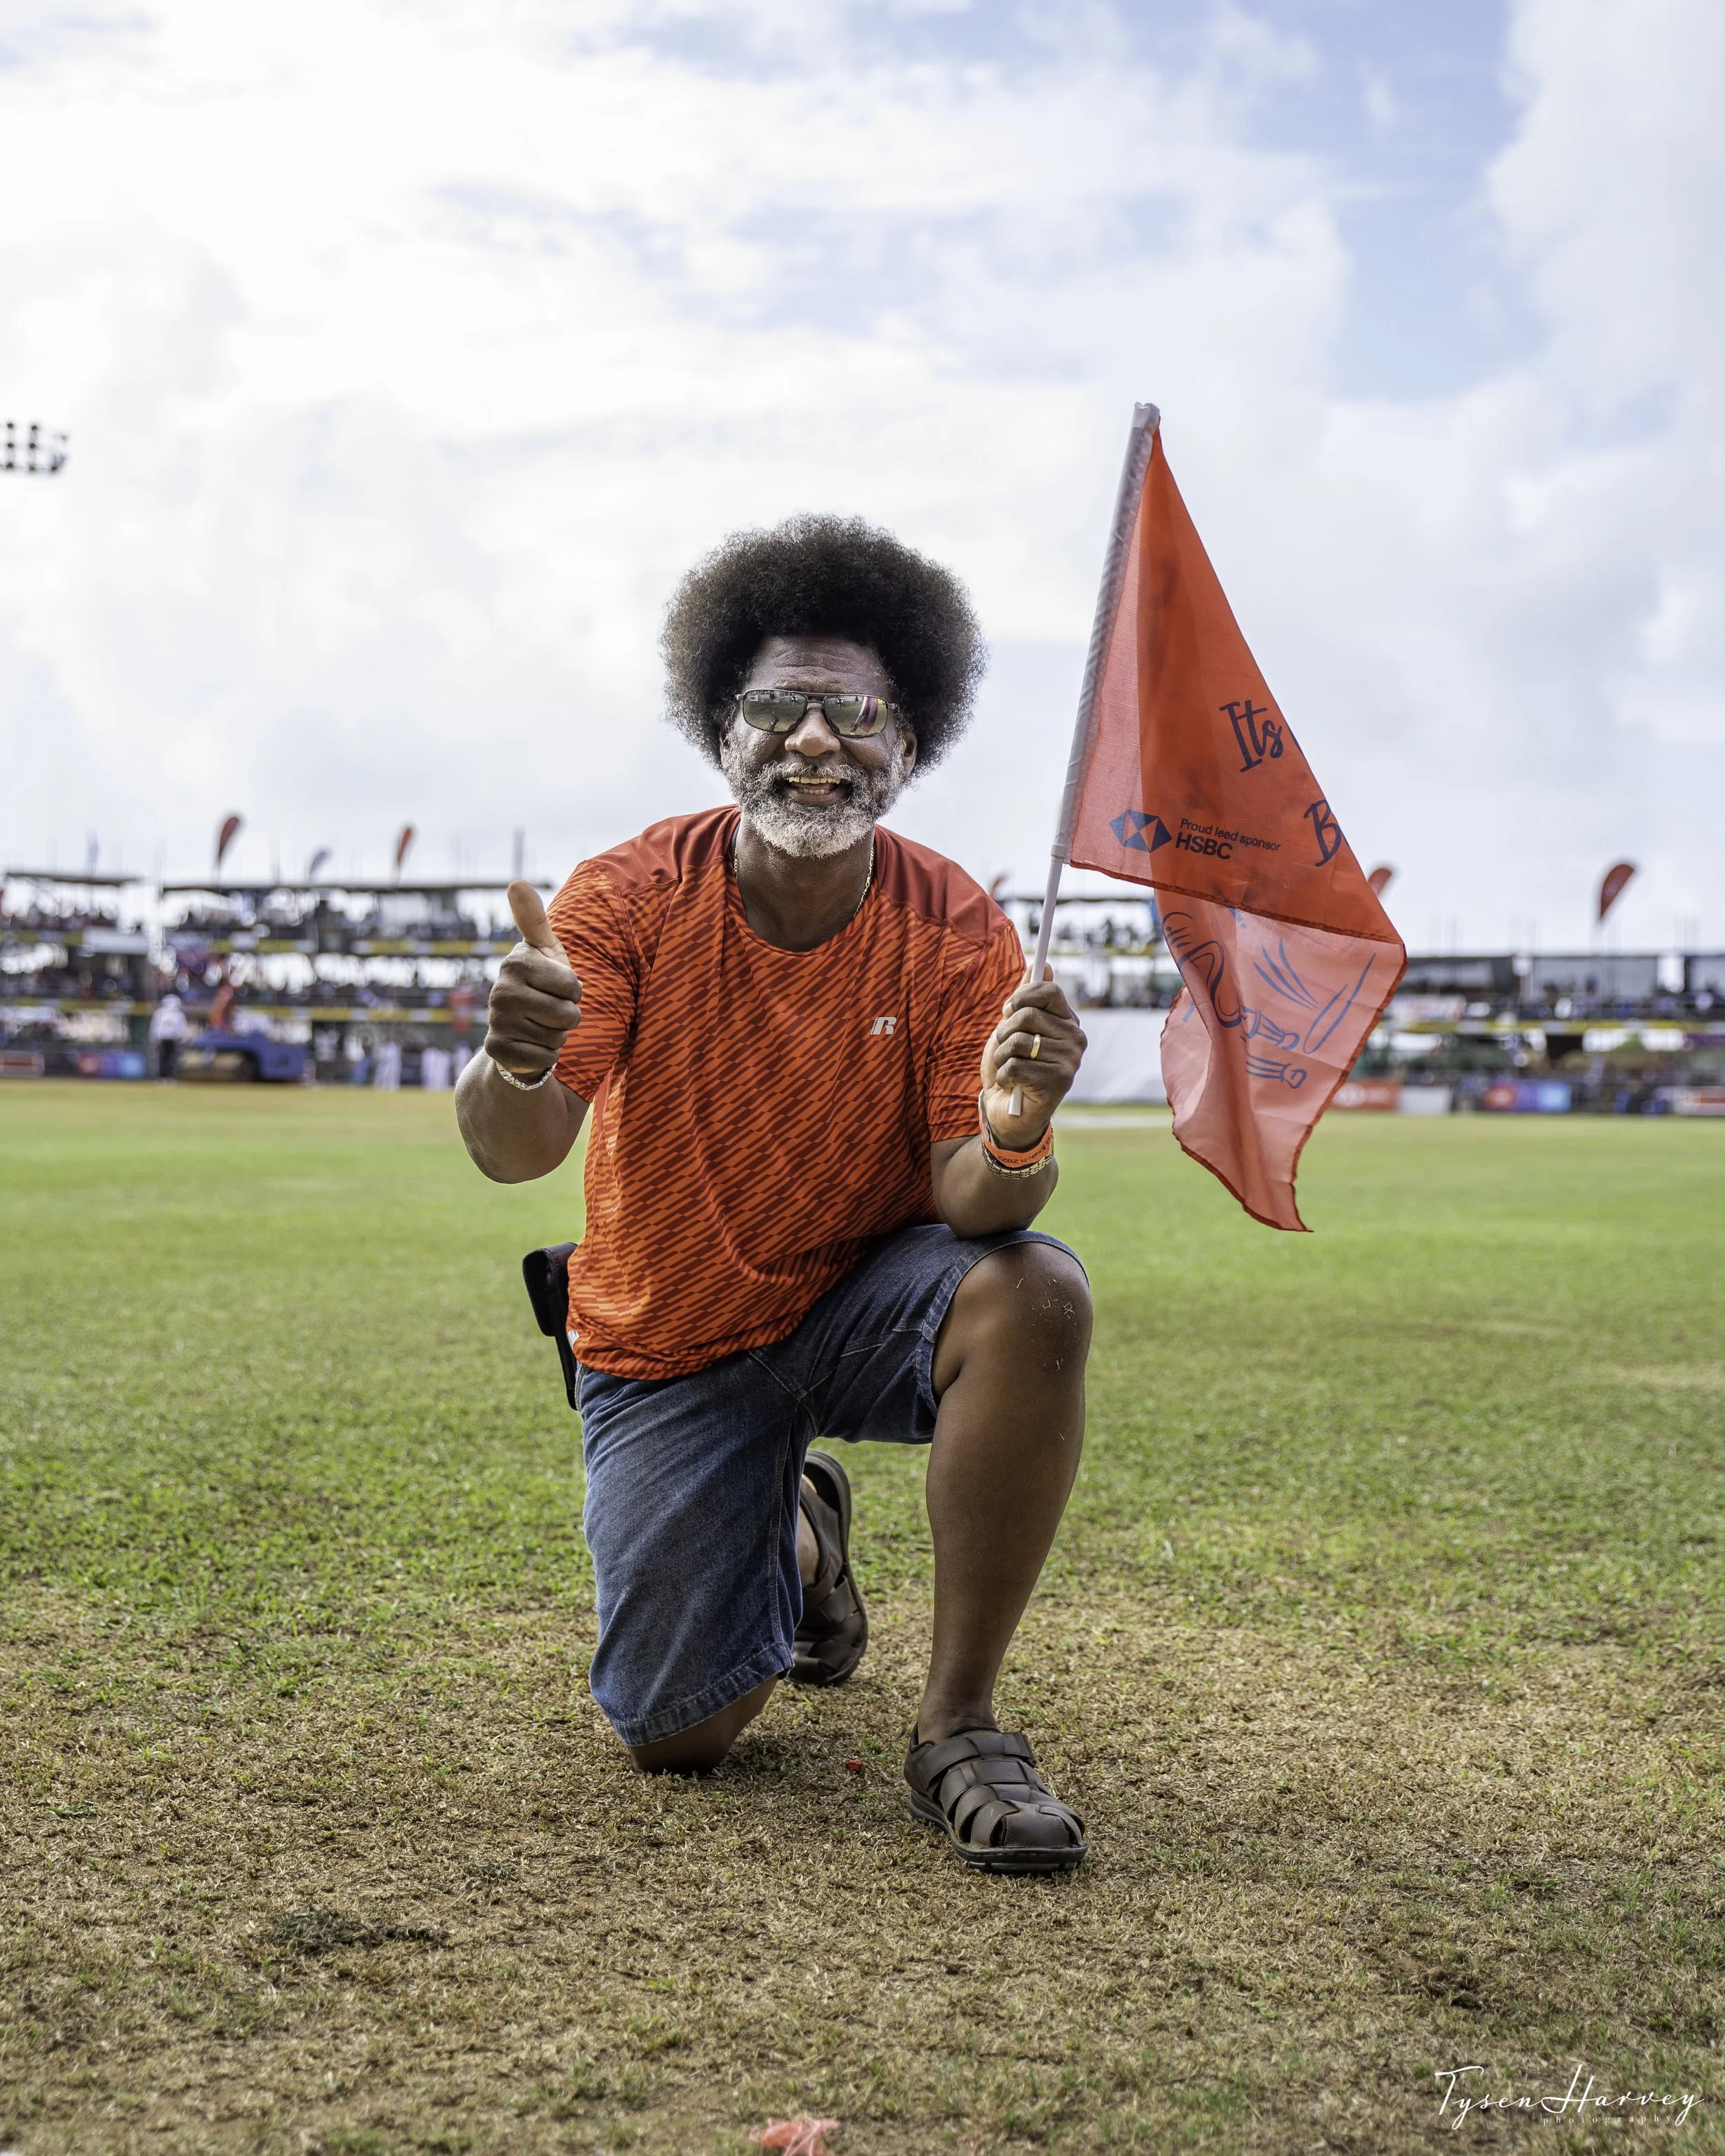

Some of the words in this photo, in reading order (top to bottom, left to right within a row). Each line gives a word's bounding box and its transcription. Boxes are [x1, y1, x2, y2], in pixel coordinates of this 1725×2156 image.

[1219, 700, 1283, 773] Its
[1175, 831, 1233, 860] HSBC
[1180, 818, 1213, 835] Proud
[1214, 827, 1239, 842] lead
[1240, 835, 1281, 851] sponsor
[998, 1156, 1018, 1164] 2022
